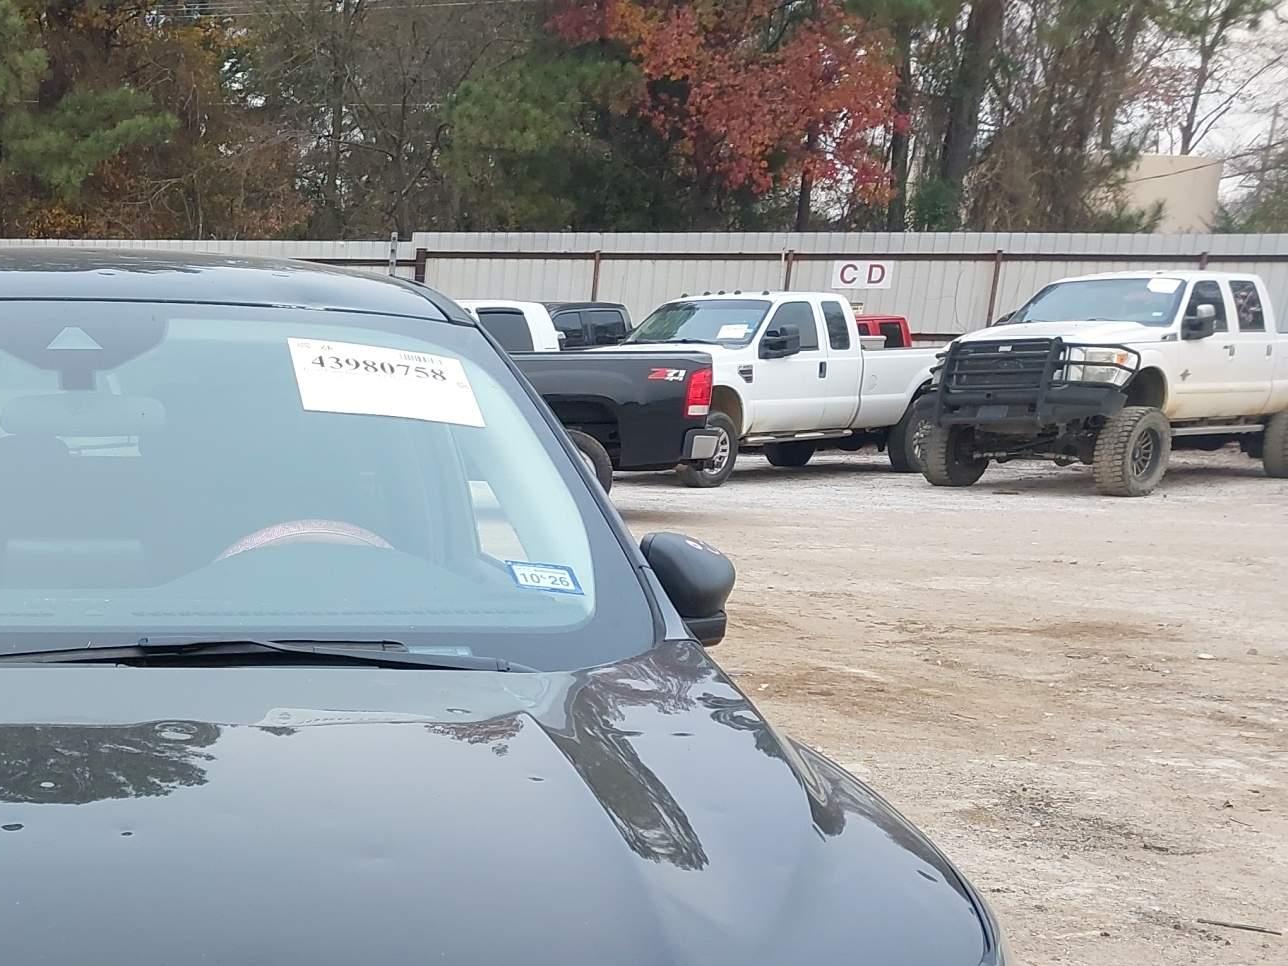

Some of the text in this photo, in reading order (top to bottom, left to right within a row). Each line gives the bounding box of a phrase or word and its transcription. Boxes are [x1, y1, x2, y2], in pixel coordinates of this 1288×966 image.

[839, 263, 886, 285] C D
[311, 354, 447, 381] 43980758
